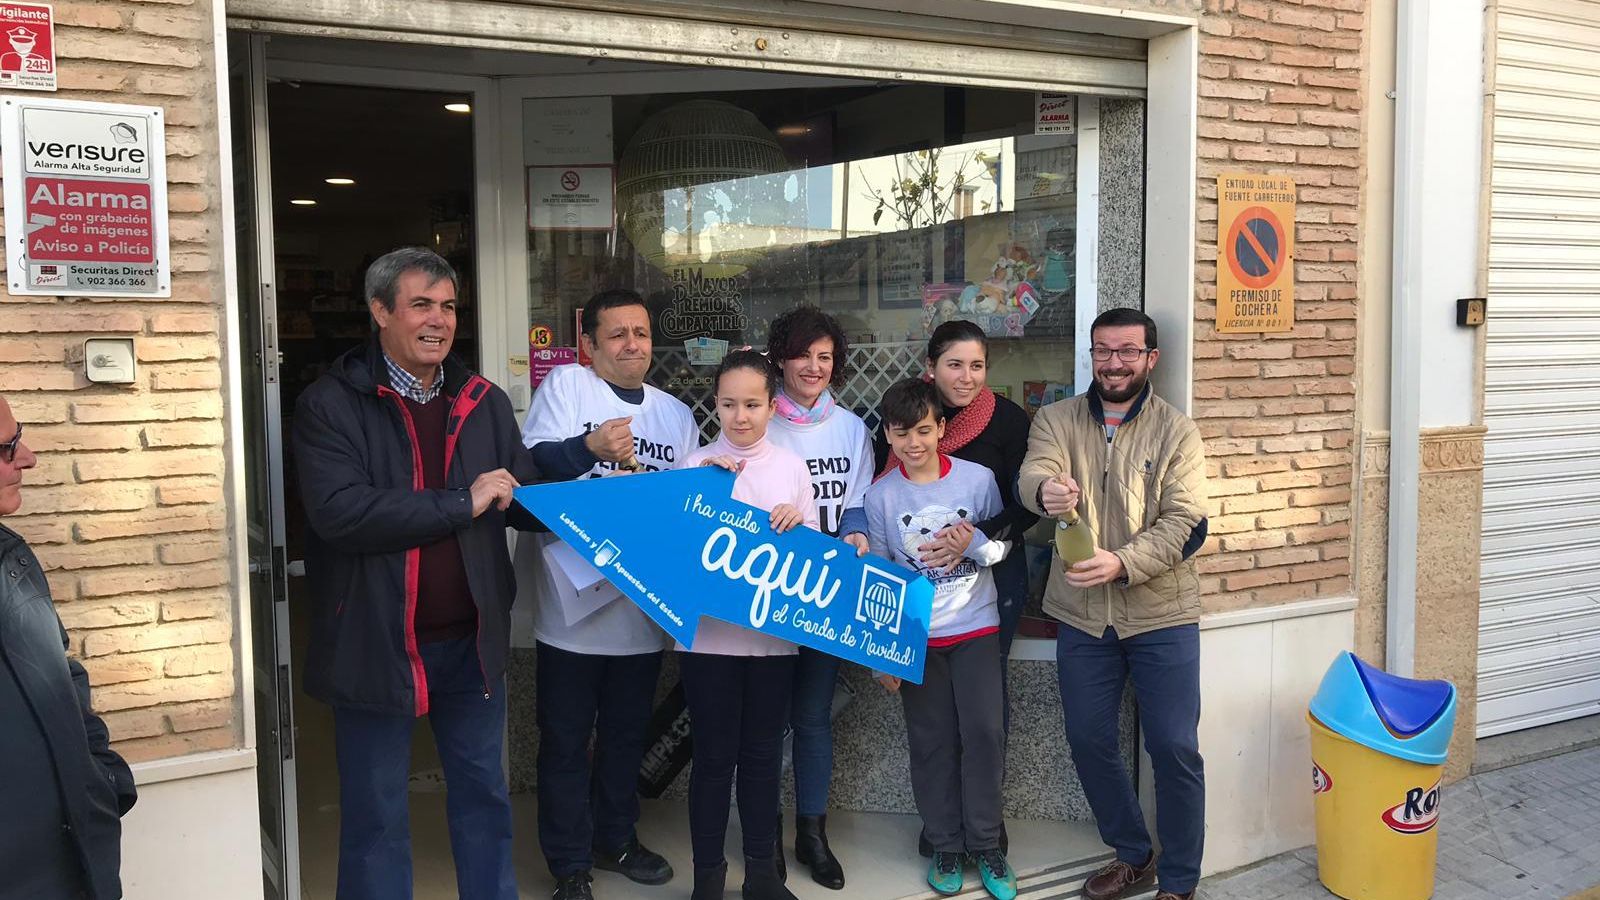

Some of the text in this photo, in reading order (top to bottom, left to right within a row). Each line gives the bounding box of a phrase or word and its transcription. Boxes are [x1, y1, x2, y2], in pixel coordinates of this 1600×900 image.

[26, 59, 49, 70] 24H
[28, 141, 145, 163] verisure
[34, 160, 142, 174] Alarma Alta Seguridad
[1225, 178, 1288, 191] ENTIDAD LOCAL DE
[30, 183, 148, 210] Alarma
[1224, 191, 1295, 203] FUENTE CARRETEROS
[59, 212, 148, 224] con grabación
[60, 223, 149, 238] de imágenes
[33, 239, 150, 255] Aviso a Policía
[70, 265, 155, 276] Securitas Direct
[672, 268, 687, 282] EL
[87, 277, 146, 286] 902 366 366
[1230, 289, 1282, 302] PERMISO DE
[1234, 302, 1279, 317] COCHERA
[1224, 318, 1254, 328] LICENCIA
[633, 436, 675, 463] EMIO
[806, 456, 851, 476] EMIO
[589, 541, 598, 549] y
[613, 561, 648, 594] Apuestas
[646, 592, 661, 605] del
[658, 602, 684, 627] Estado
[701, 526, 842, 629] aquí
[772, 603, 916, 667] el Gordo de Navidad!
